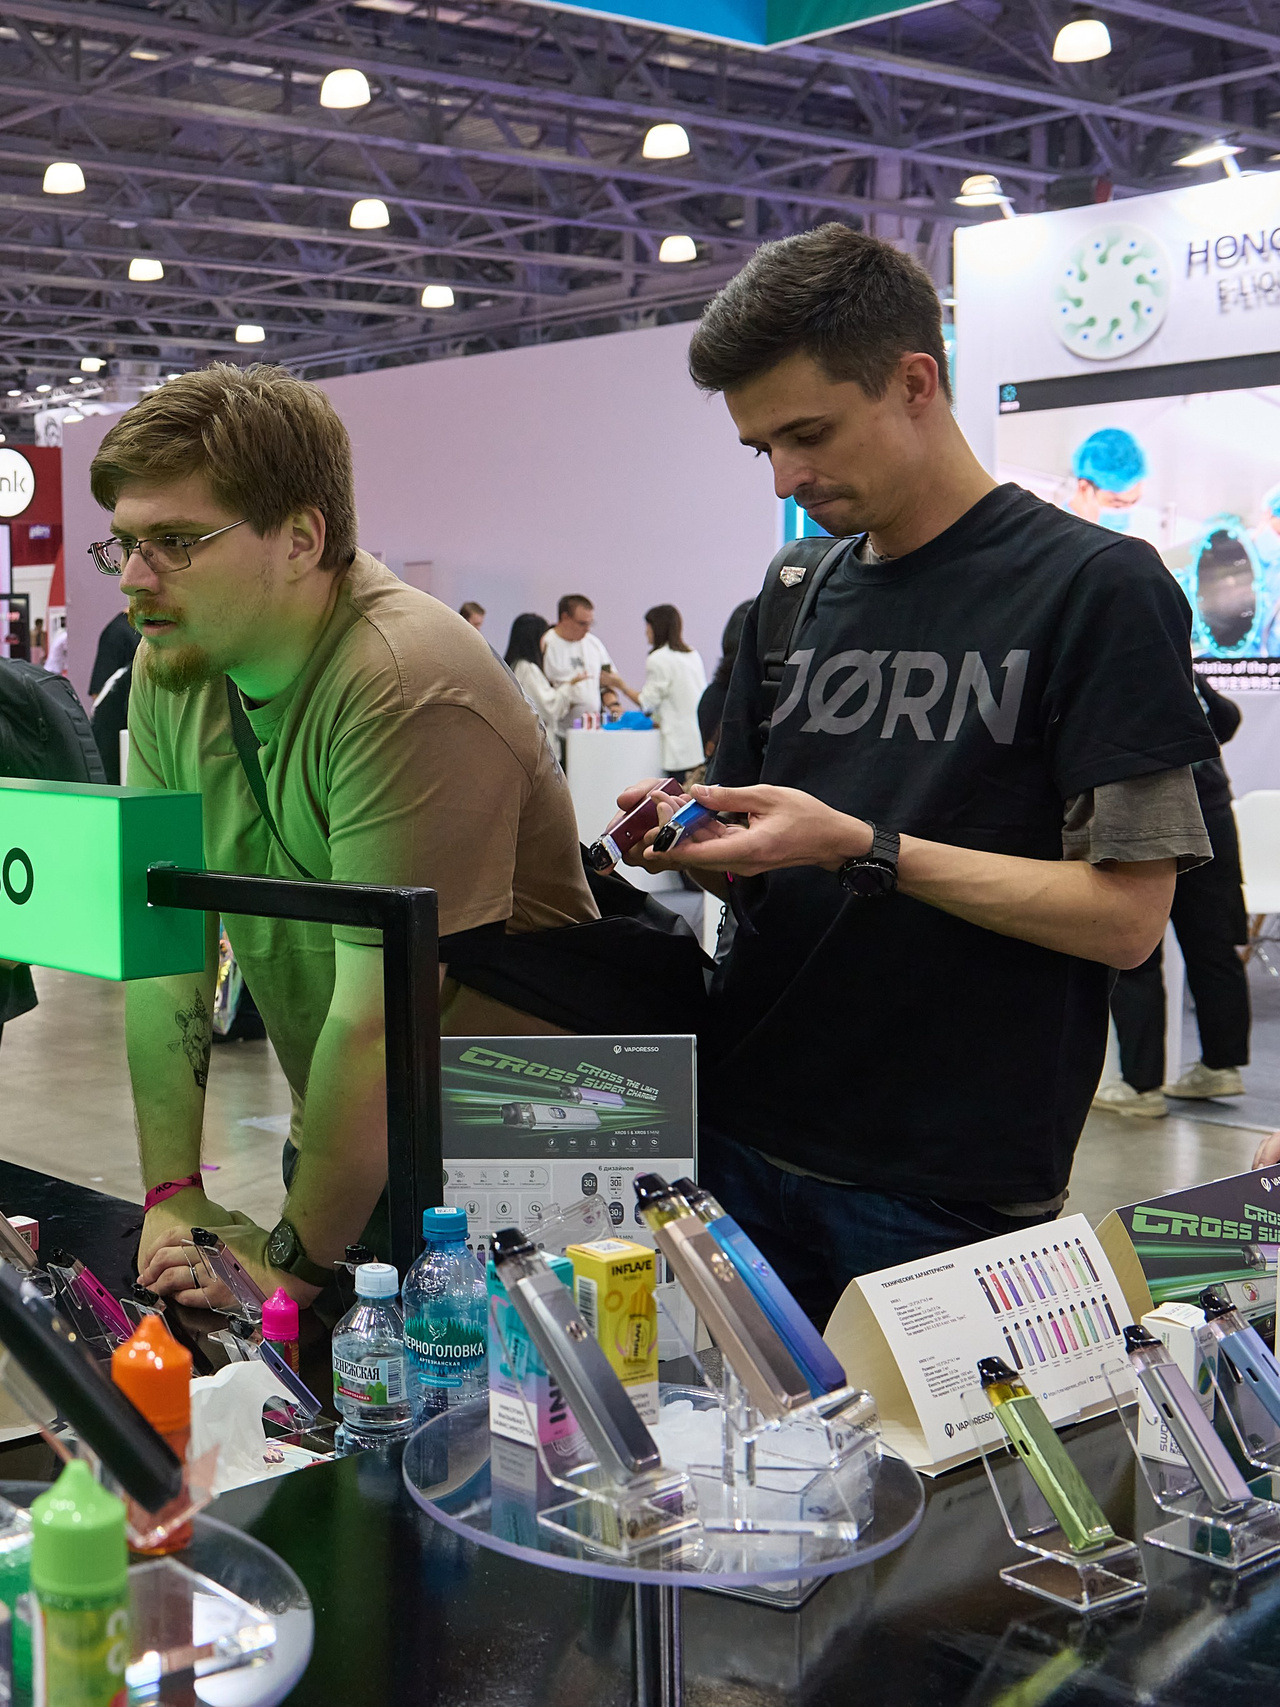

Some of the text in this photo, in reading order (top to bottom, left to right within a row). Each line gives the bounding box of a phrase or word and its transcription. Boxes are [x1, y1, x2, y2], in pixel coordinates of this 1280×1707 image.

[771, 648, 1030, 745] JØRN
[459, 1046, 580, 1084] CROSS
[576, 1061, 659, 1095] CROSS THE LIMITS
[581, 1077, 626, 1095] SUPER
[583, 1179, 593, 1187] 30
[609, 1179, 618, 1187] 30
[1132, 1205, 1253, 1240] CROSS
[881, 1263, 955, 1289] ТЕХНИЧЕСКИЕ ХАРАКТЕРИСТИКИ
[419, 1357, 461, 1366] АРТЕЗИАНСКАЯ
